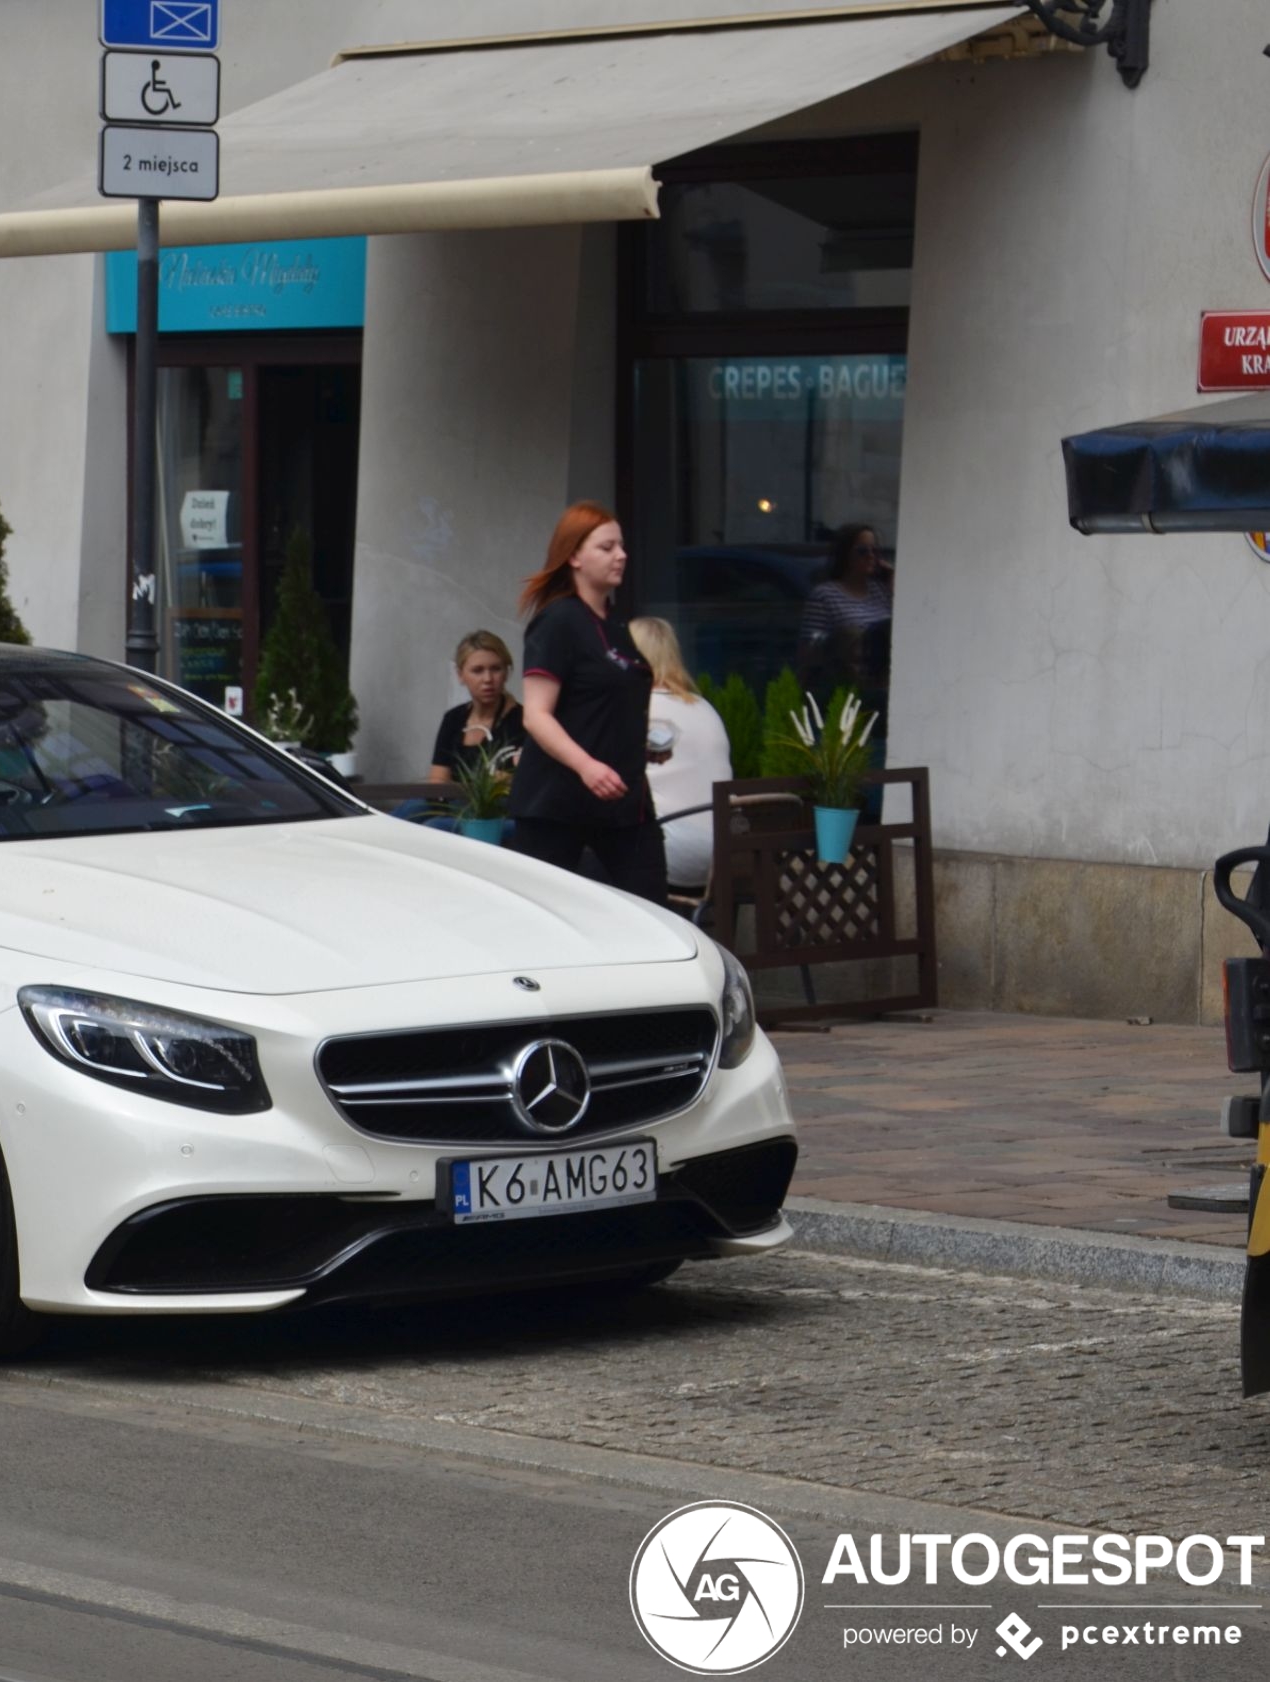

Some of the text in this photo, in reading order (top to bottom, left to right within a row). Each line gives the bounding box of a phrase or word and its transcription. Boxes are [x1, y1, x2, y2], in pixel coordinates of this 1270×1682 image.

[123, 154, 199, 176] 2 miejsca
[1224, 325, 1270, 351] URZĄ
[708, 365, 802, 399] CREPES
[478, 1148, 648, 1208] K6 AMG63
[455, 1195, 469, 1206] PL
